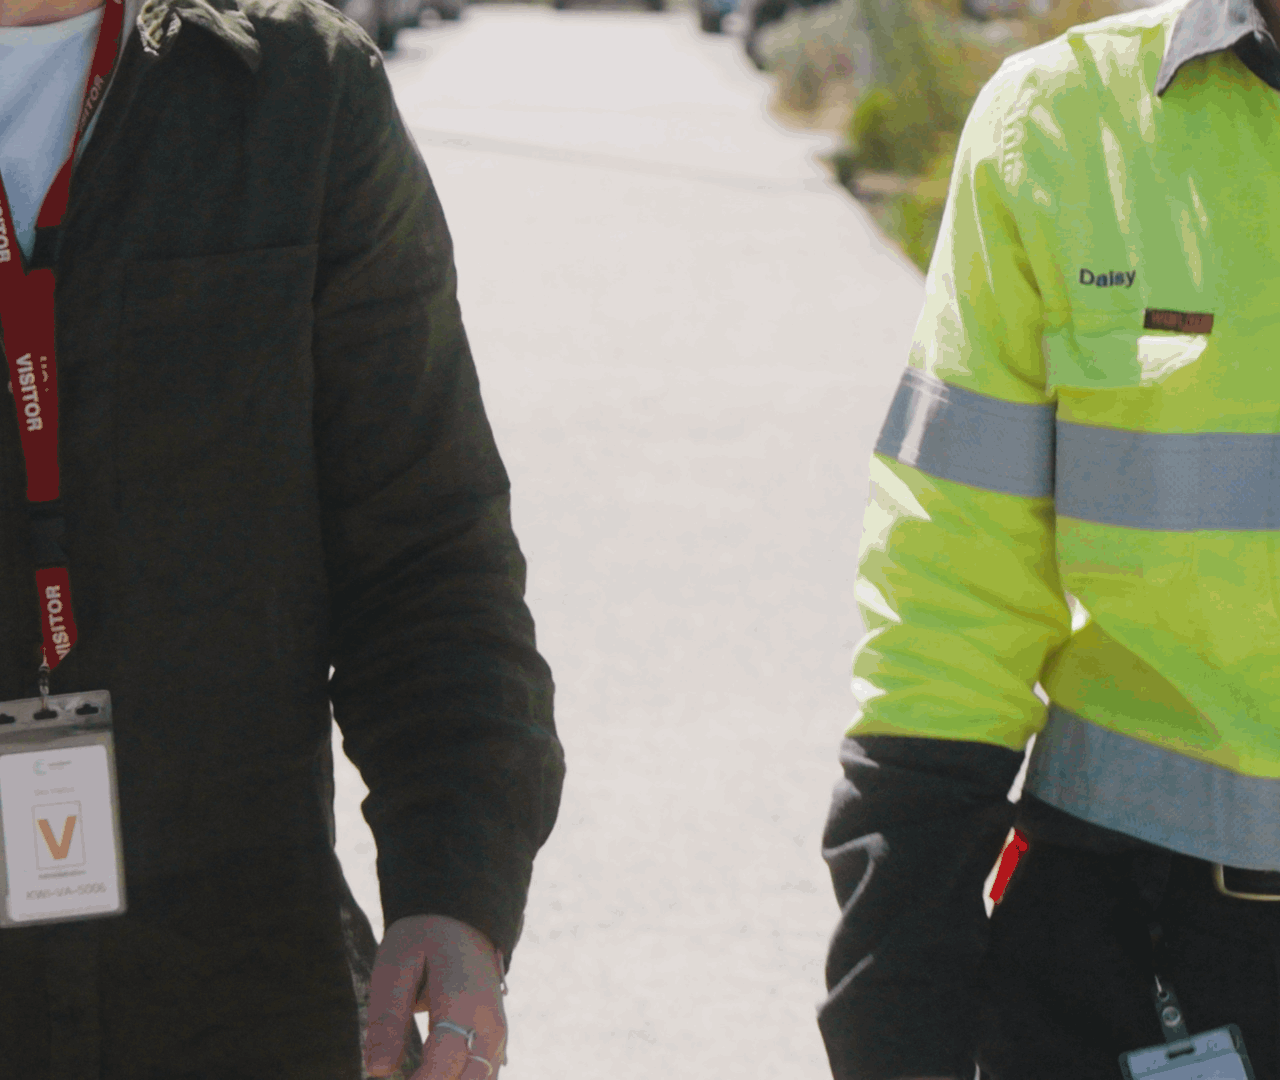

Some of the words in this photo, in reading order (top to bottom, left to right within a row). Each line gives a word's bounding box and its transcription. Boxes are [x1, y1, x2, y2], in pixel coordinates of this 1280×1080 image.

[1079, 267, 1137, 290] Daisy
[16, 352, 43, 432] VISITOR
[45, 584, 71, 661] VISITOR
[36, 815, 77, 860] V
